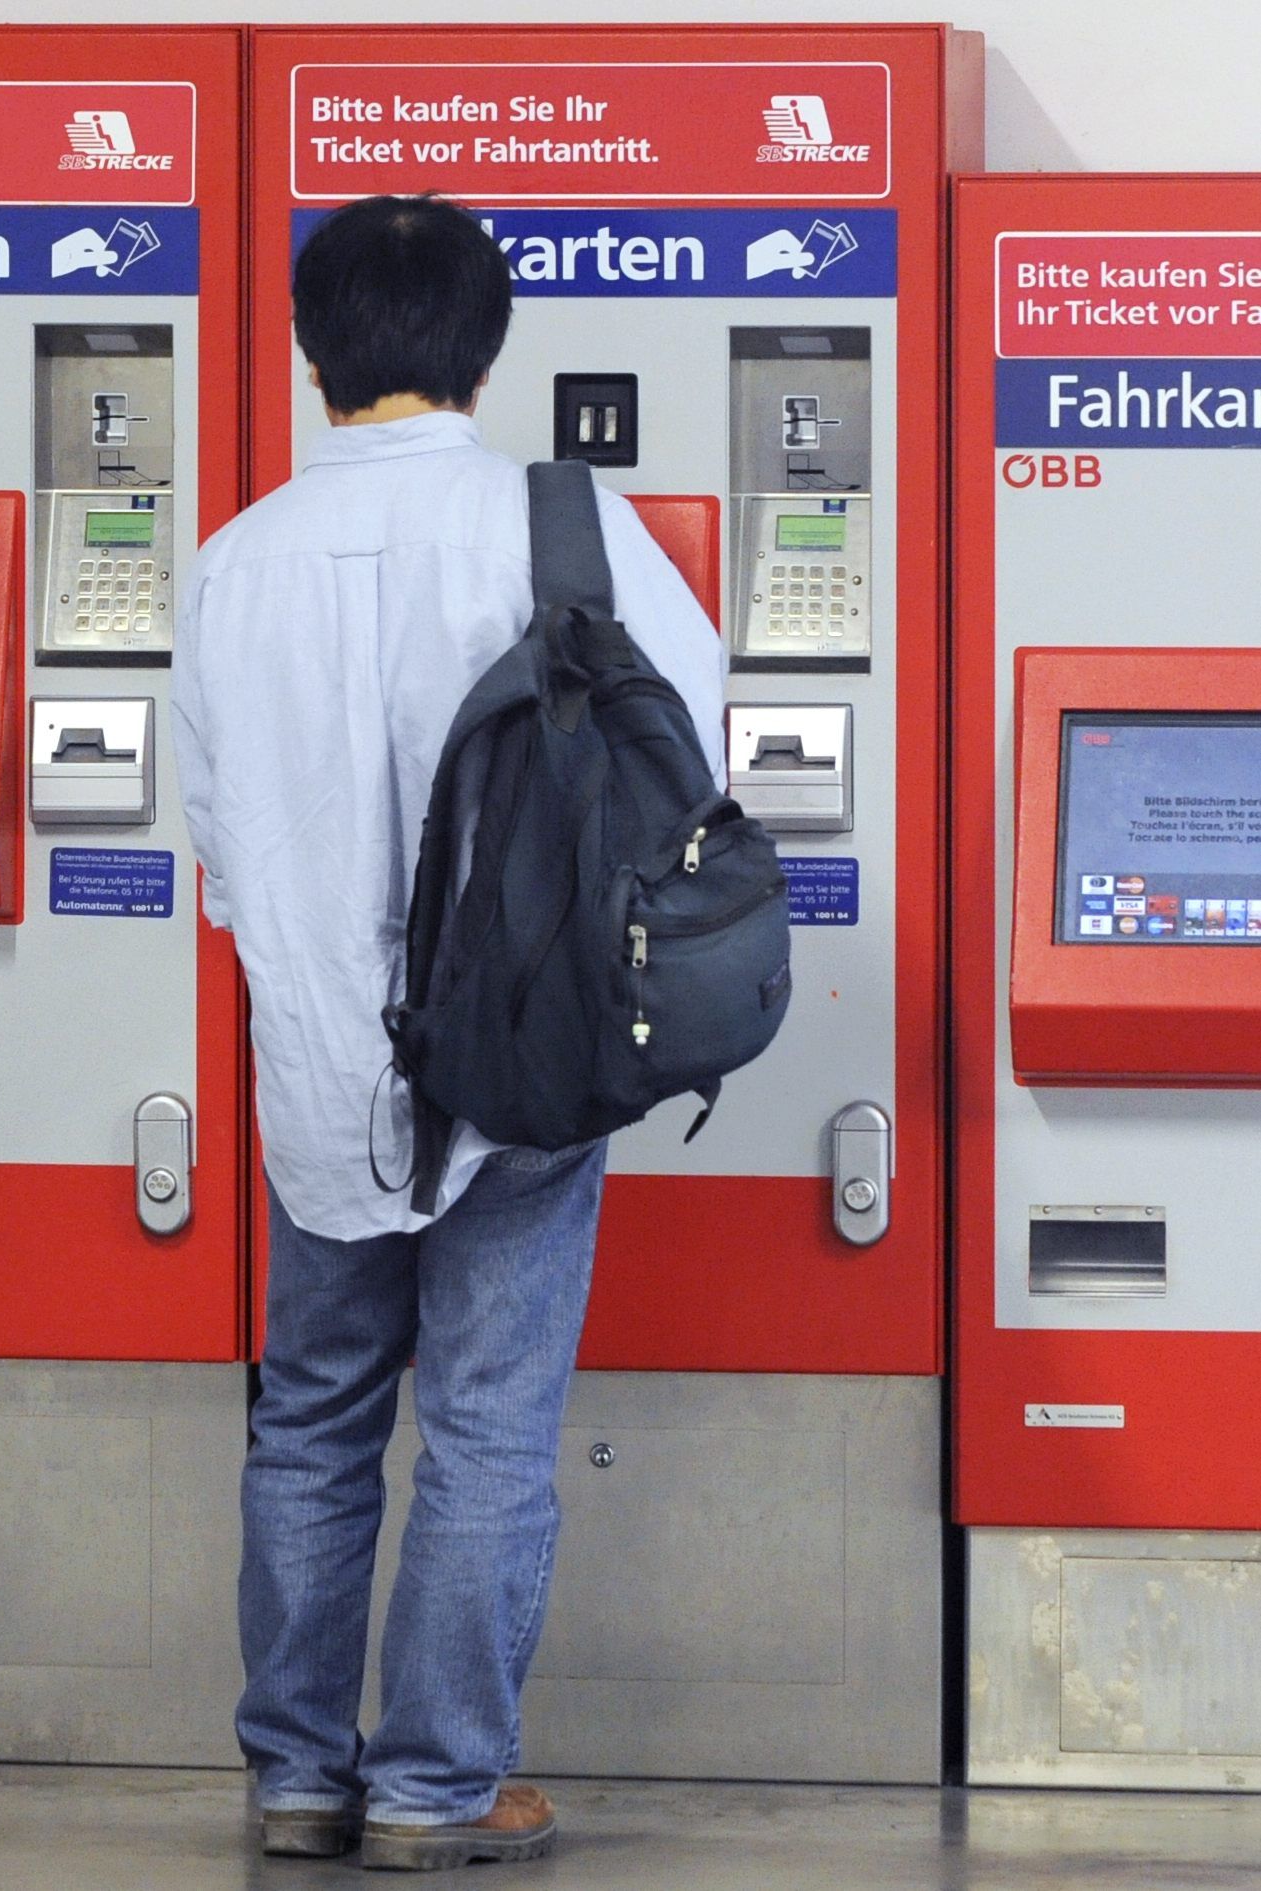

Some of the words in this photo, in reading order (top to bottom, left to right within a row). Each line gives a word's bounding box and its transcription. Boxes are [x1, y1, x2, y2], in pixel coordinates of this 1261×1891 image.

[313, 96, 382, 121] Bitte
[394, 95, 497, 121] kaufen
[510, 96, 554, 121] Sie
[567, 95, 607, 121] Ihr
[311, 136, 403, 162] Ticket
[413, 143, 463, 162] vor
[475, 136, 658, 162] Fahrtantritt.
[1018, 263, 1089, 287] Bitte
[1101, 261, 1206, 287] kaufen
[1219, 262, 1261, 287] Sie
[1019, 299, 1059, 325] Ihr
[1065, 299, 1158, 324] Ticket
[1169, 306, 1219, 324] vor
[1003, 454, 1101, 488] ÖBB
[1144, 797, 1172, 806] Bitte
[1175, 797, 1236, 806] Bildschirm
[1240, 797, 1261, 806] ber
[1149, 809, 1187, 818] Please
[1190, 809, 1222, 818] touch
[1226, 809, 1245, 818] the
[58, 875, 71, 883] Bei
[73, 875, 106, 885] Störung
[108, 876, 130, 885] rufen
[132, 877, 144, 886] Sie
[146, 877, 166, 887] bitte
[121, 888, 131, 896] 05
[791, 885, 813, 893] rufen
[816, 885, 828, 893] Sie
[830, 885, 850, 894] bitte
[56, 900, 125, 911] Automatennr.
[805, 896, 816, 904] 05
